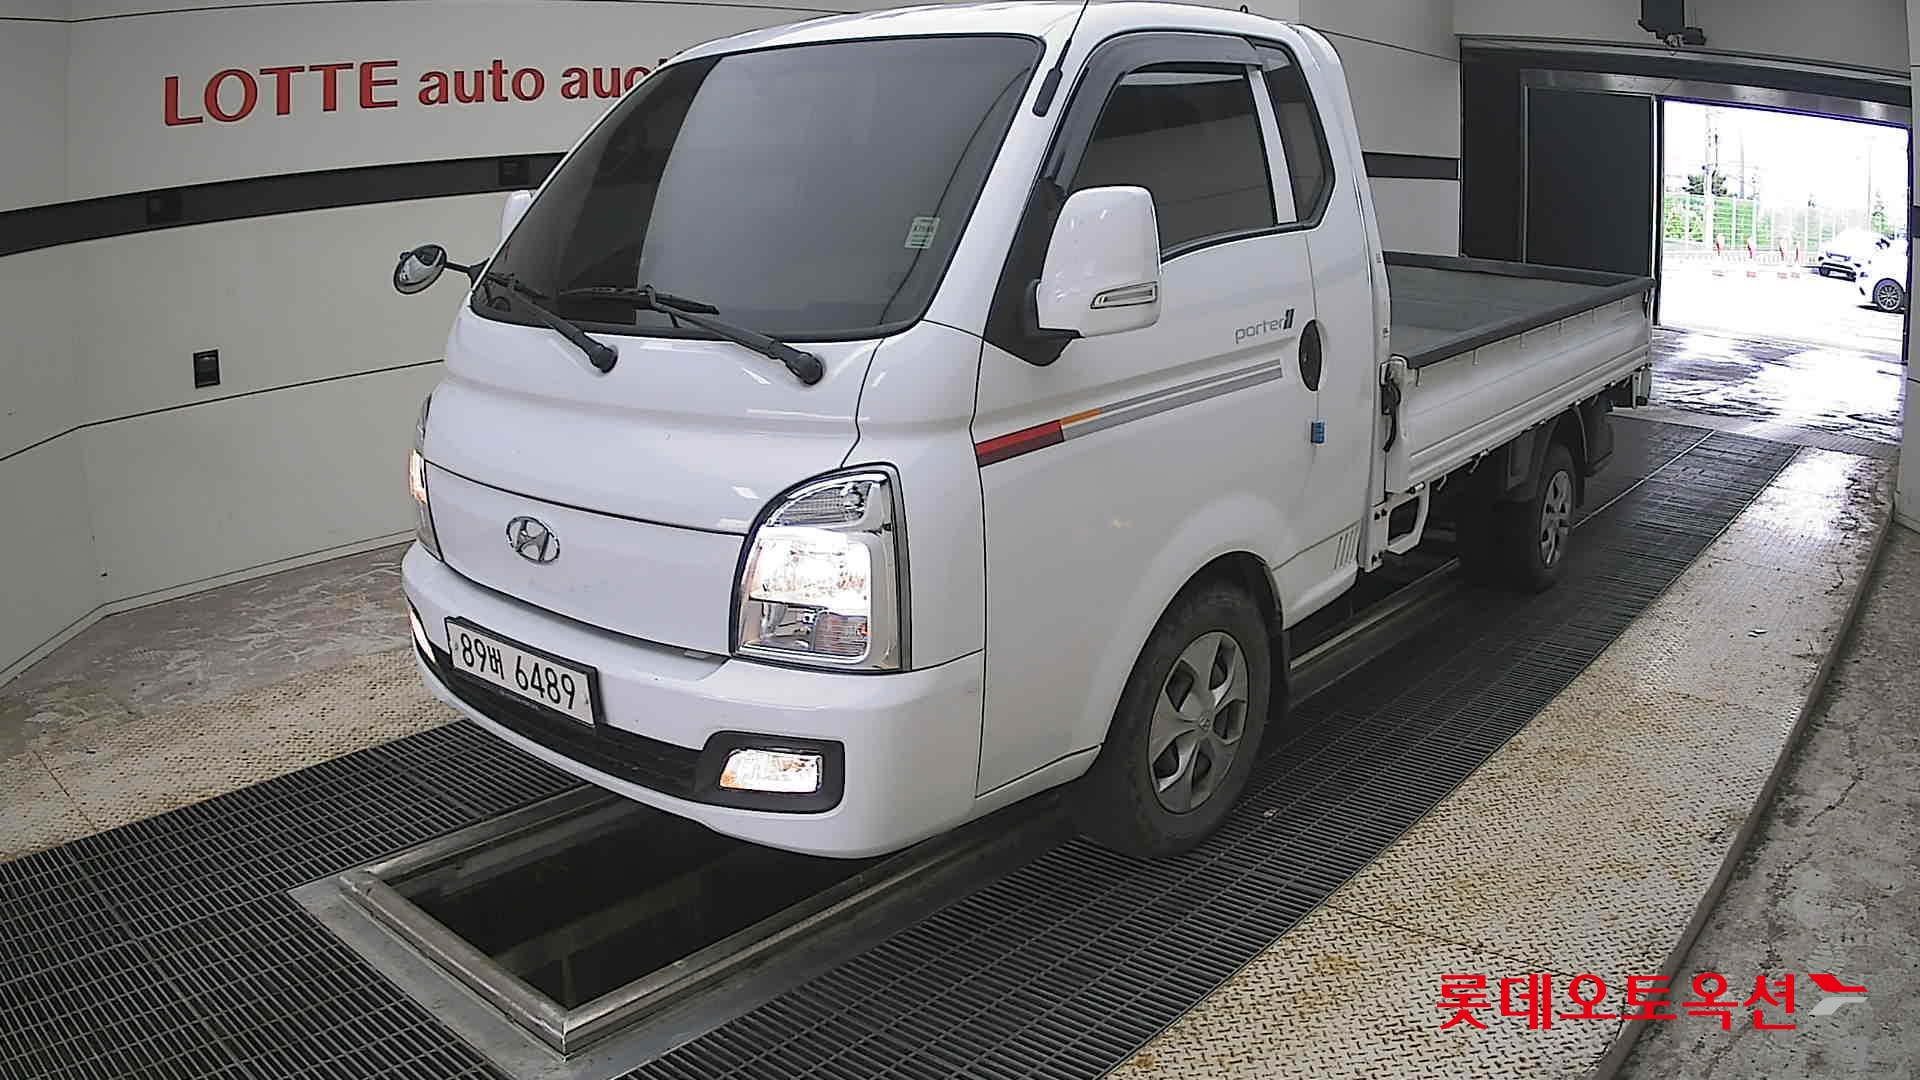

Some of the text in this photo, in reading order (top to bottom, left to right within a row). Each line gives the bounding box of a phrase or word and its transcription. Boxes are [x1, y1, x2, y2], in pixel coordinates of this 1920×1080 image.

[165, 58, 668, 126] LOTTE auto auc
[460, 633, 576, 710] 89버 6489
